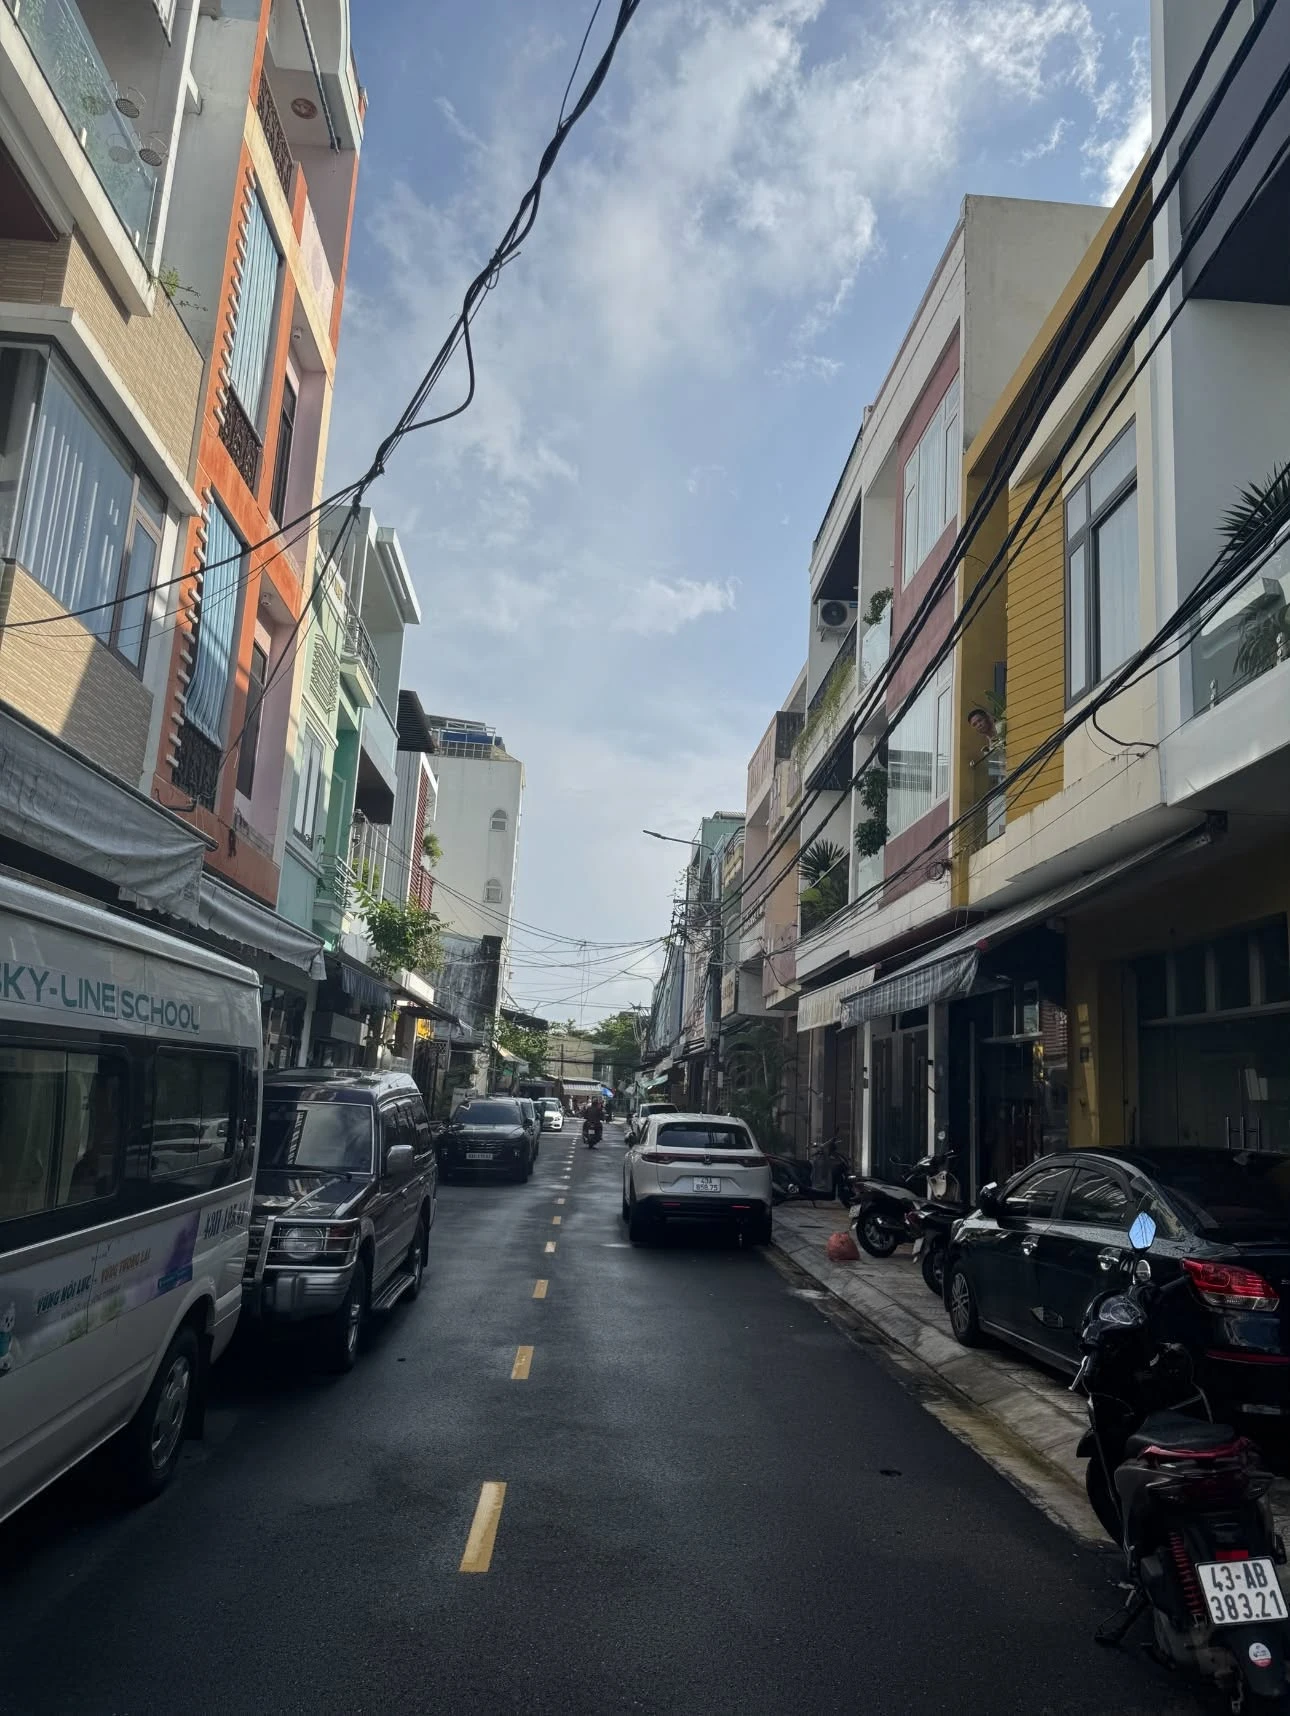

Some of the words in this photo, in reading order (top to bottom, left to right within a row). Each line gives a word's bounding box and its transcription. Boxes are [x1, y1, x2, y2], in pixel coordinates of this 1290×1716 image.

[0, 962, 116, 1014] KY-LINE
[121, 989, 200, 1031] SCHOOL
[1210, 1562, 1269, 1592] 43-AB
[1210, 1589, 1284, 1622] 383.21
